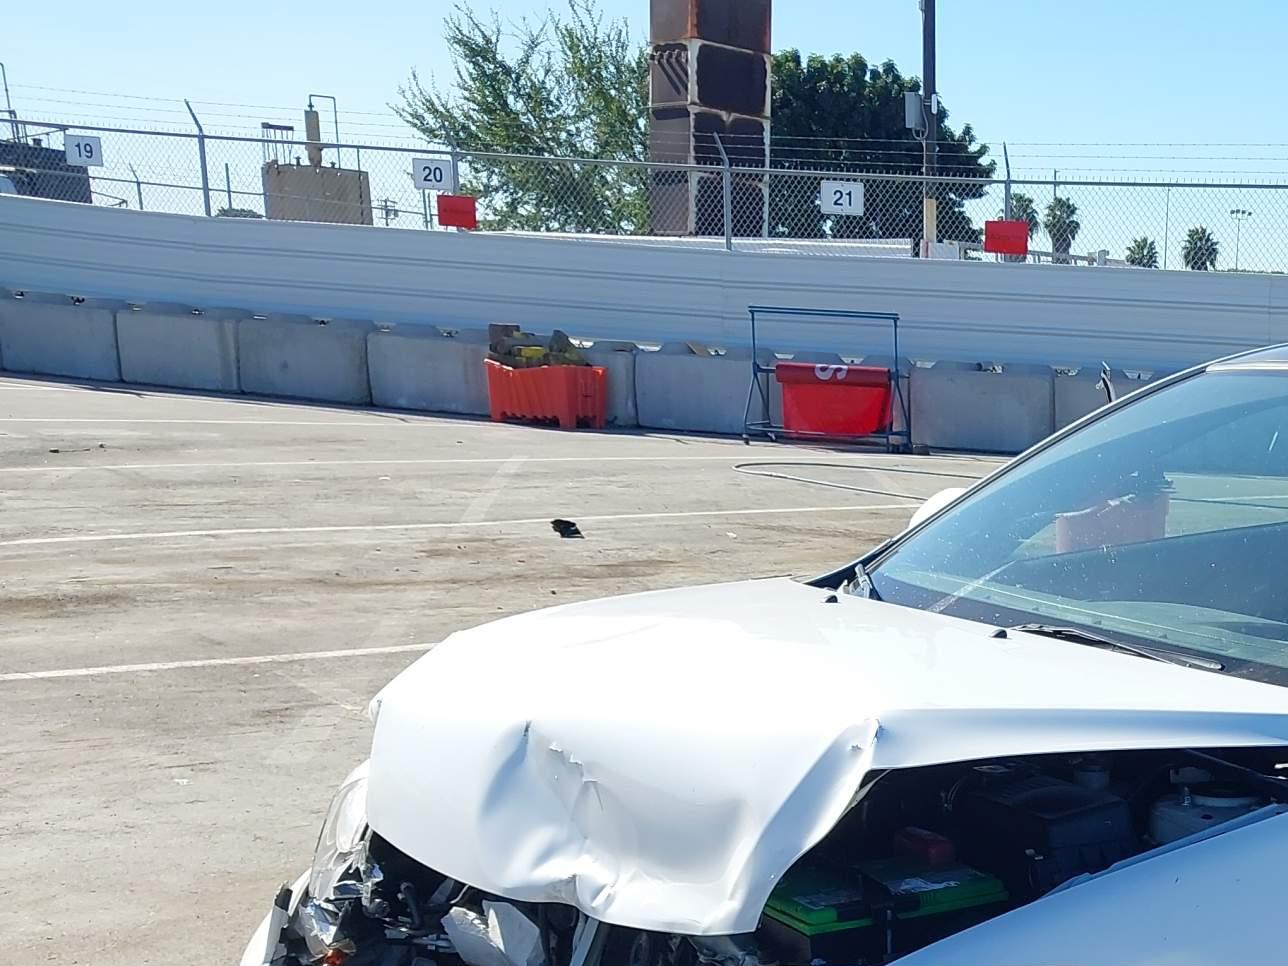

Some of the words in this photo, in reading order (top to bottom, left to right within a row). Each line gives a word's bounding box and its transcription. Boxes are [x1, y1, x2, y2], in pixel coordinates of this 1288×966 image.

[74, 142, 93, 159] 19
[422, 166, 443, 183] 20
[833, 190, 852, 207] 21
